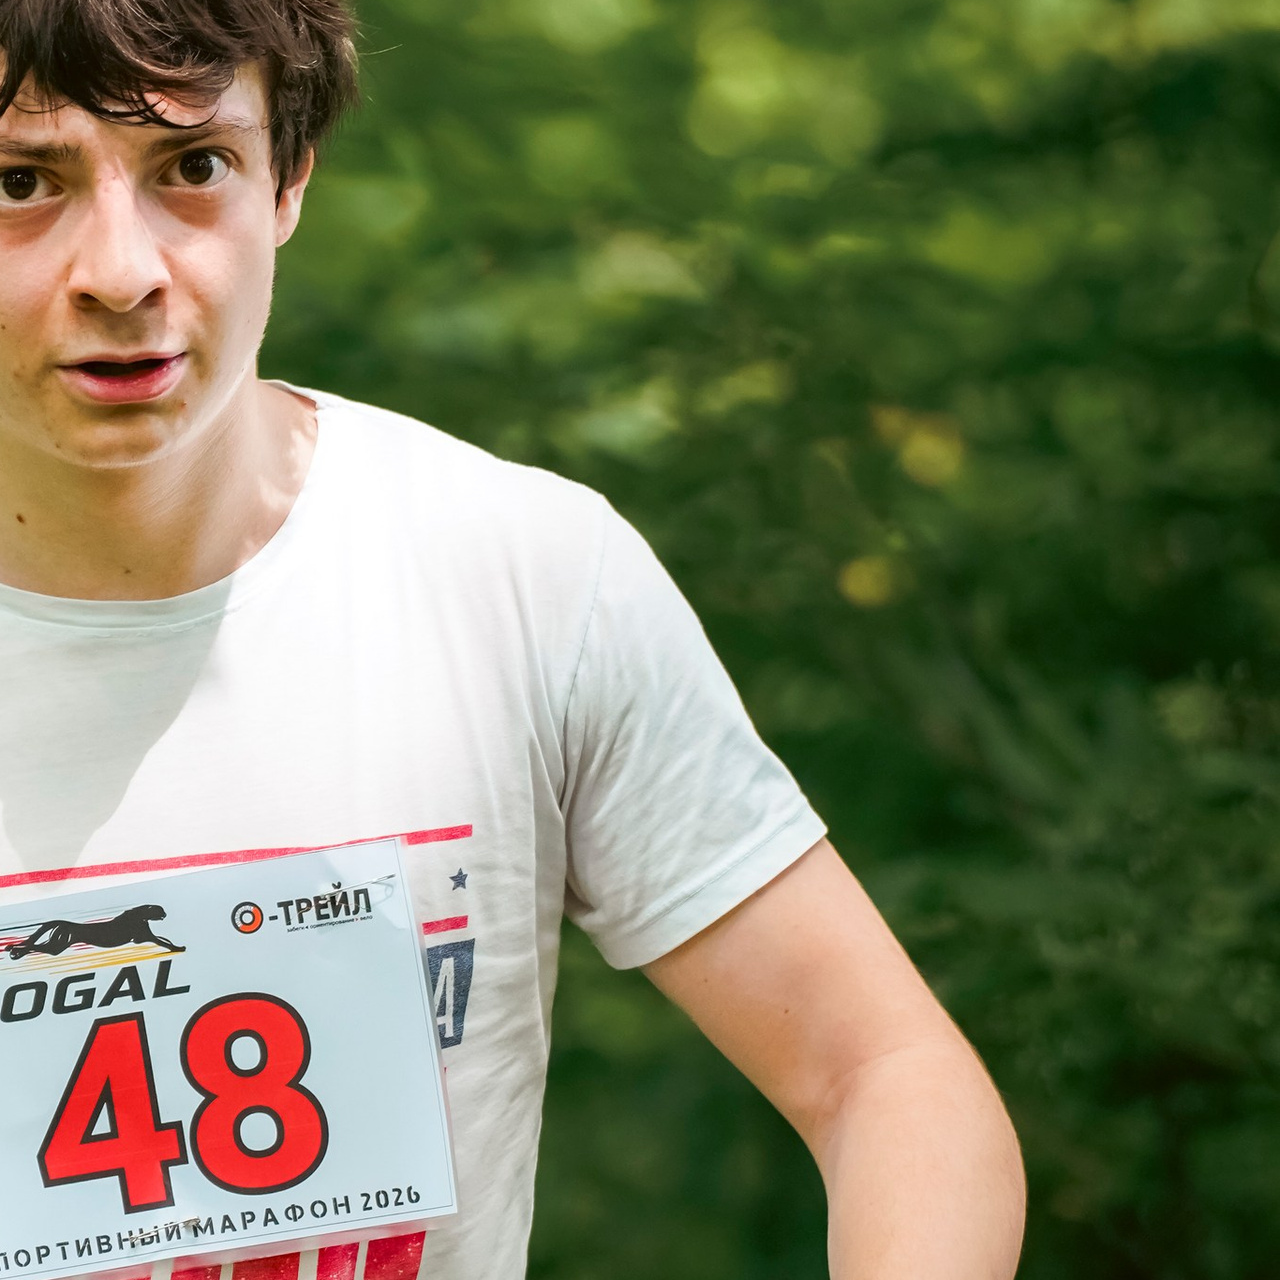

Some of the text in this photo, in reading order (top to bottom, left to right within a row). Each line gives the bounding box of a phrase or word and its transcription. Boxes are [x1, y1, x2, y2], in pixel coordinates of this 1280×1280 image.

[37, 992, 329, 1214] 48
[192, 1195, 351, 1238] МАРАФОН
[360, 1186, 421, 1212] 2026
